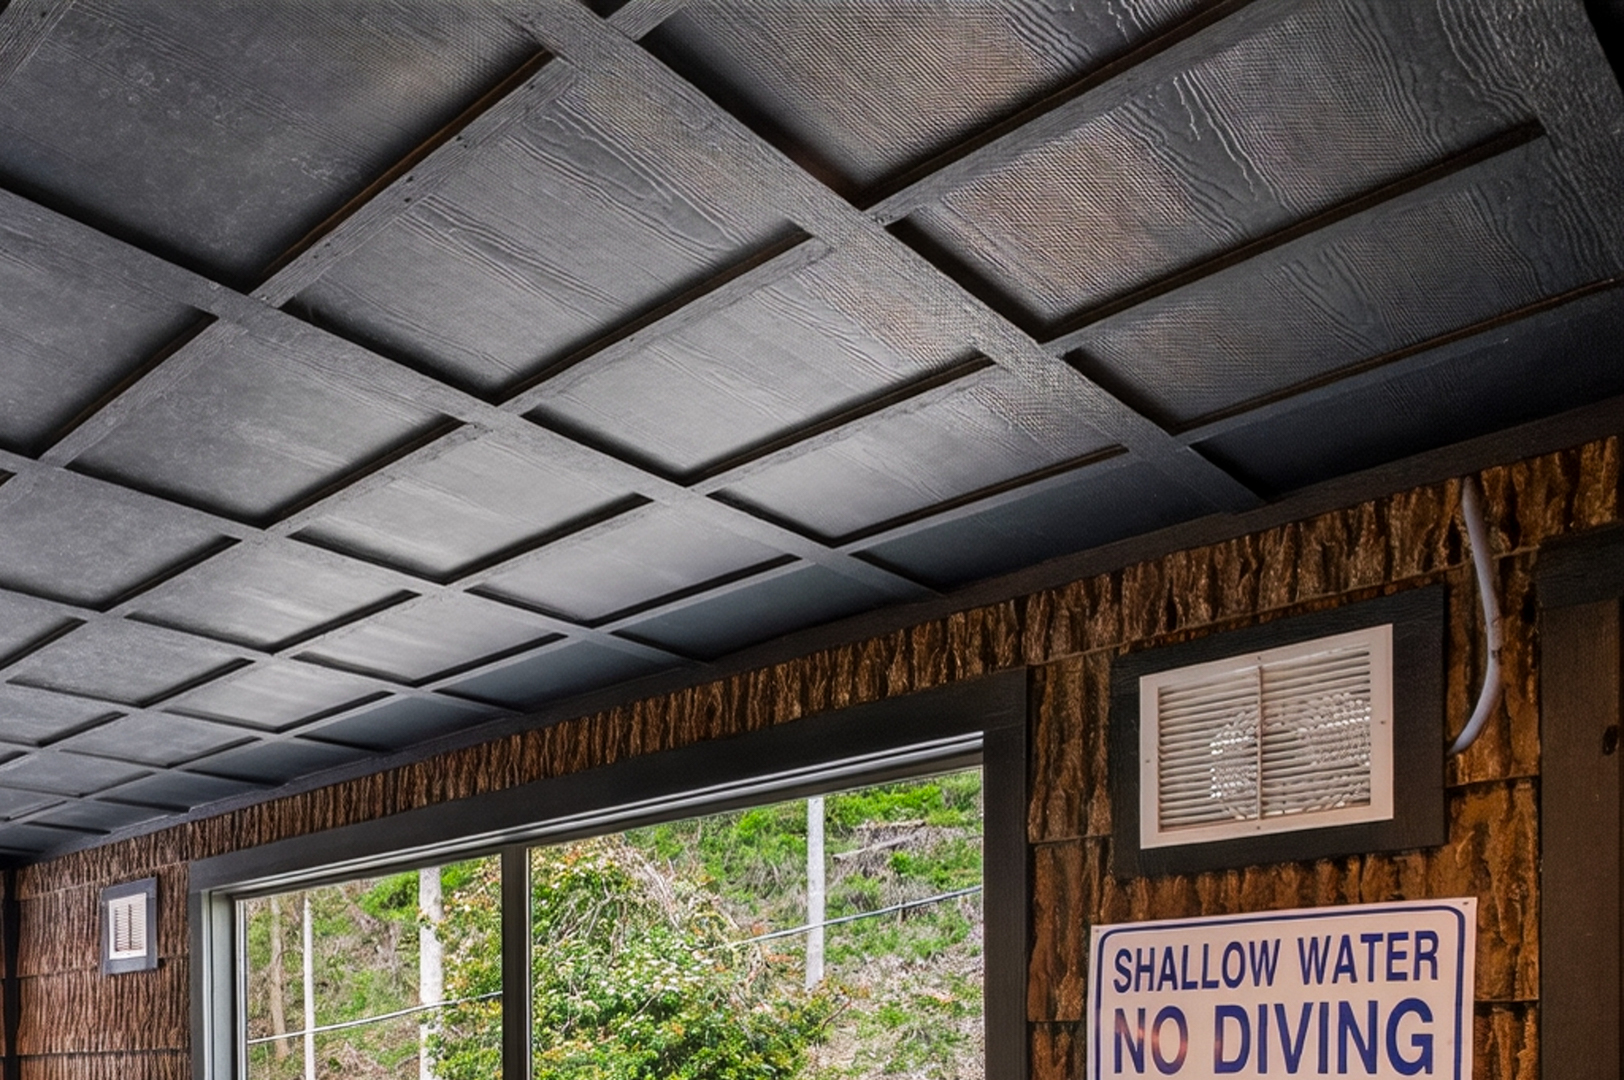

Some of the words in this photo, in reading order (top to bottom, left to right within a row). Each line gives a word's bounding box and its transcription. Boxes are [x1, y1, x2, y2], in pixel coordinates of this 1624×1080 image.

[1113, 939, 1281, 994] SHALLOW
[1297, 930, 1440, 985] WATER
[1113, 1005, 1189, 1075] NO
[1213, 997, 1435, 1076] DIVING
